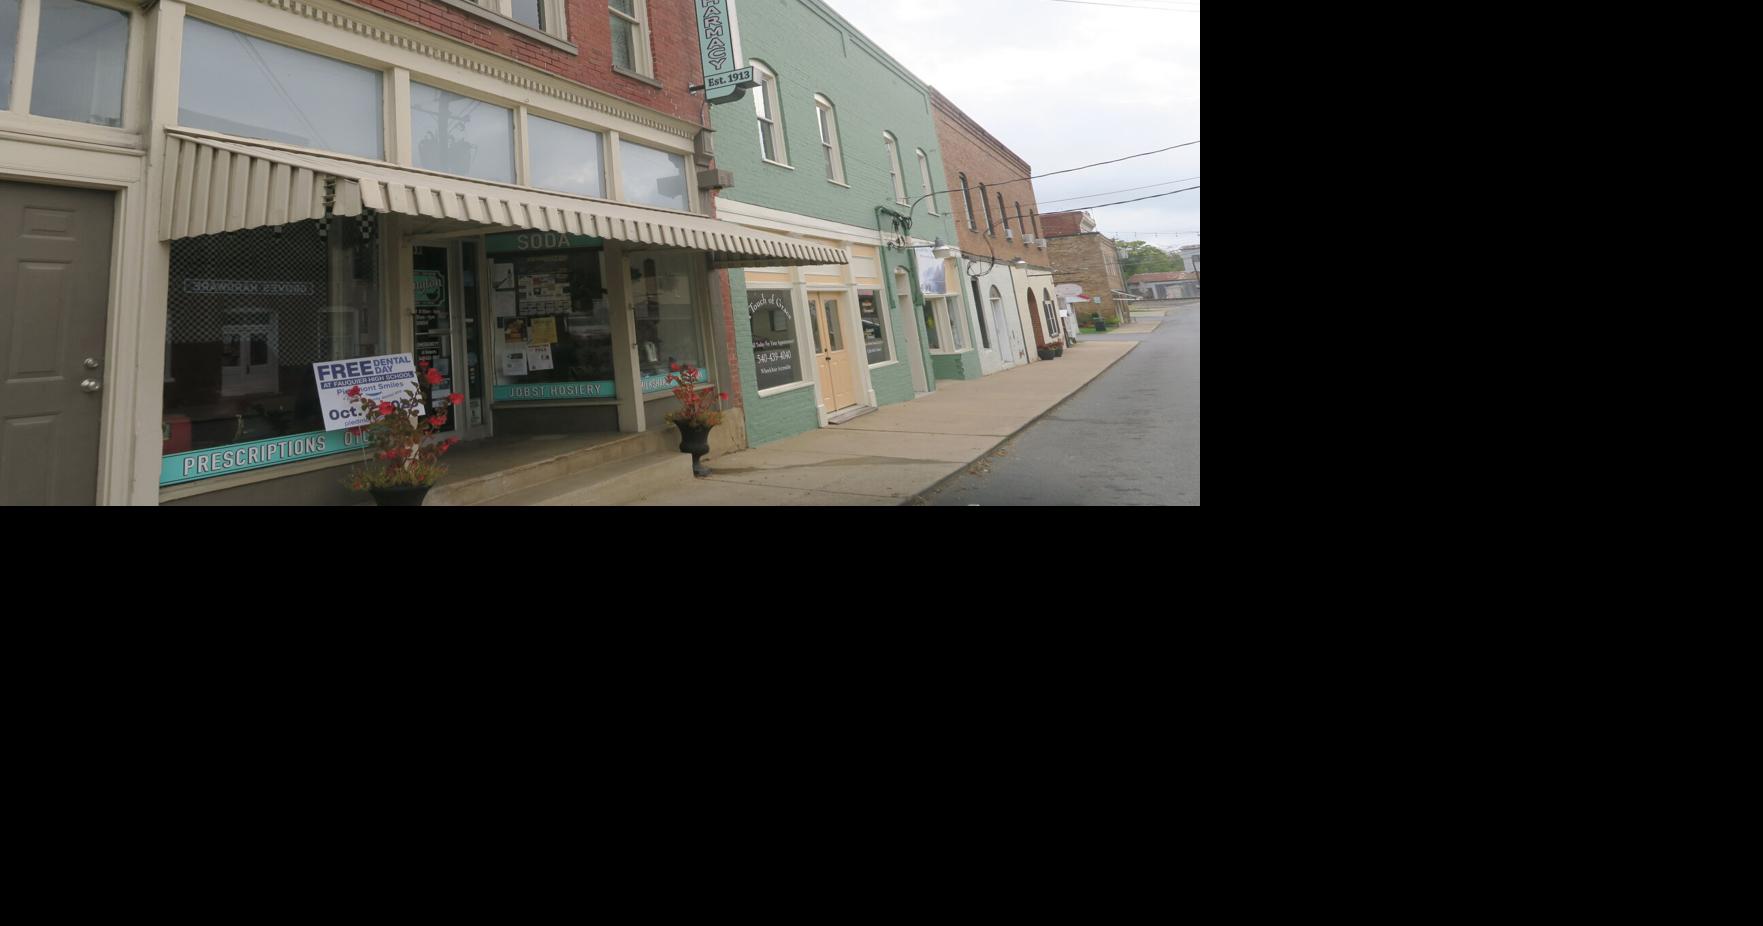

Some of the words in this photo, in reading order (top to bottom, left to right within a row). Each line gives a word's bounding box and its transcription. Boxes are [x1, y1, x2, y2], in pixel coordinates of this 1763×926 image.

[708, 76, 726, 87] Est.
[728, 71, 750, 82] 1913
[517, 232, 571, 250] SODA
[748, 292, 767, 313] Touch
[768, 293, 775, 305] of
[317, 361, 374, 381] FREE
[374, 356, 411, 366] DENTAL
[375, 365, 393, 374] DAY
[323, 381, 332, 389] AT
[333, 378, 368, 388] FAUQUIER
[368, 375, 385, 383] HIGH
[385, 372, 413, 380] SCHOOL
[377, 381, 404, 390] Smiles
[510, 386, 545, 397] JOBST
[550, 384, 601, 396] HOSIERY
[329, 406, 362, 420] Oct.
[183, 435, 326, 477] PRESCRIPTIONS
